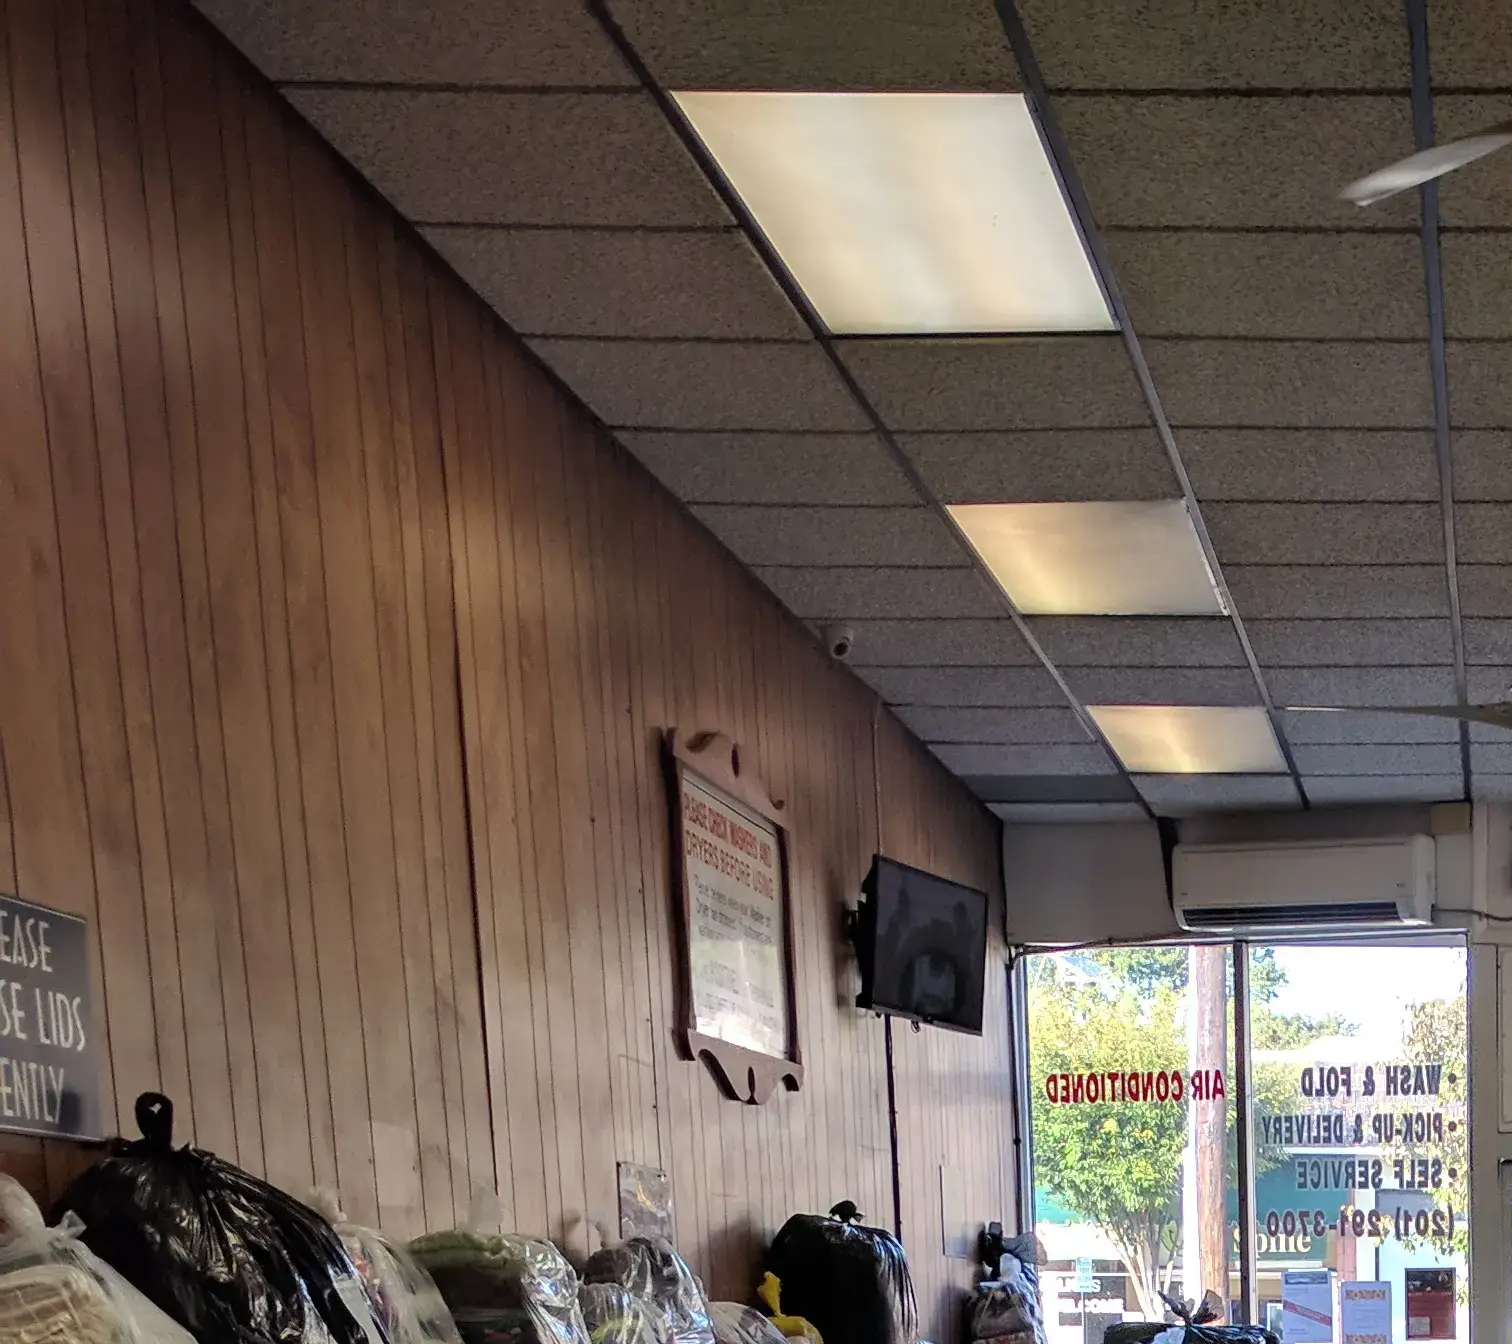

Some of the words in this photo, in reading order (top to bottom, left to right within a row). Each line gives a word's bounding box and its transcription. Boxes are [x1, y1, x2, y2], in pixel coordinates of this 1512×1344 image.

[0, 910, 53, 972] EASE
[35, 988, 86, 1051] LIDS
[0, 1057, 64, 1124] ENTLY
